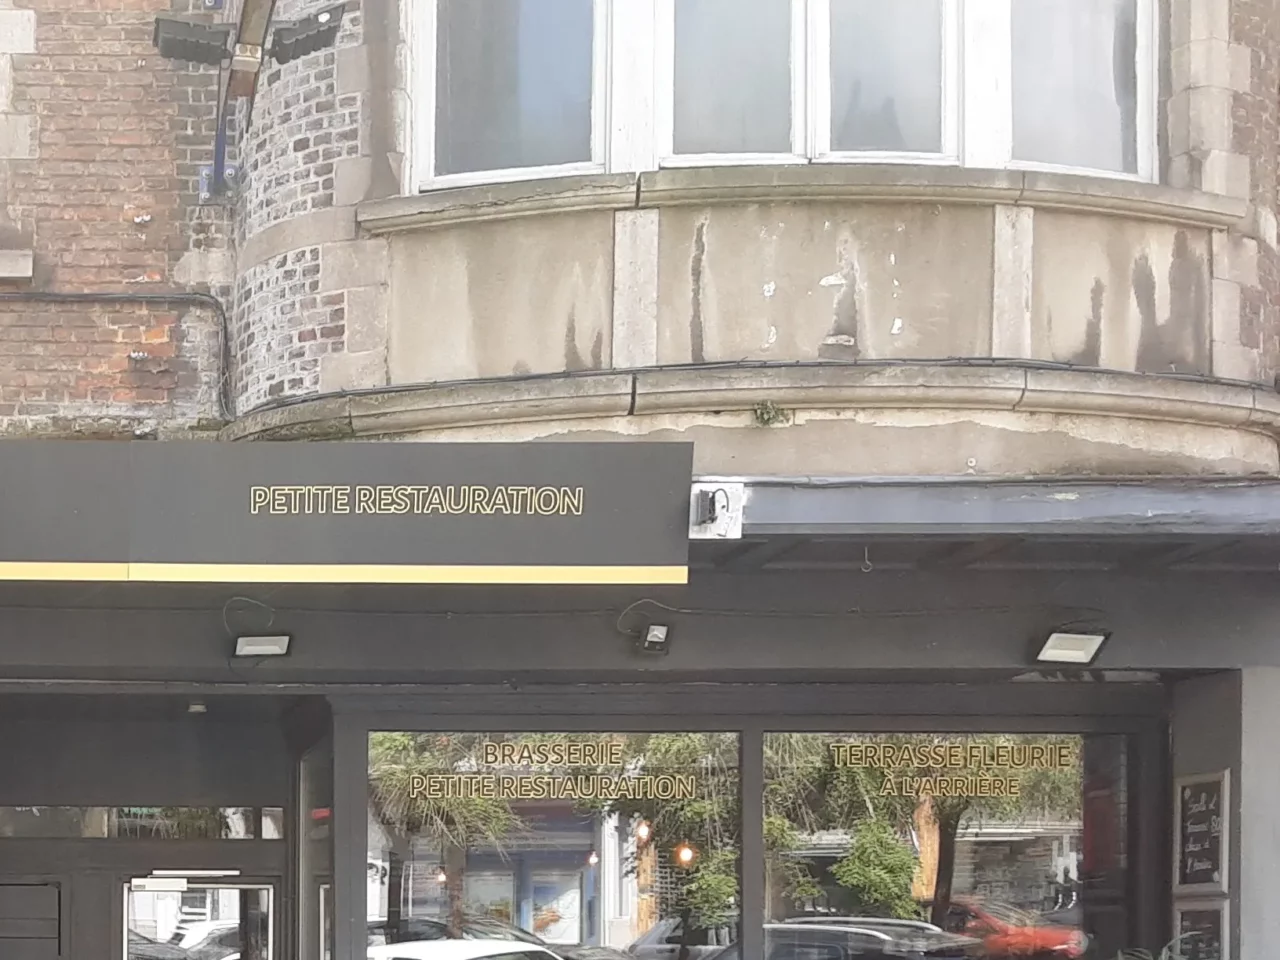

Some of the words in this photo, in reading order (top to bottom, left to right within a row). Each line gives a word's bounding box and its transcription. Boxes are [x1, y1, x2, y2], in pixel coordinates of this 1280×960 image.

[250, 485, 351, 515] PETITE
[355, 485, 584, 516] RESTAURATION
[482, 742, 623, 767] BRASSERIE
[830, 743, 962, 768] TERRASSE
[966, 744, 1071, 769] FLEURIE
[409, 774, 495, 799] PETITE
[500, 774, 697, 800] RESTAURATION
[879, 771, 898, 797] À
